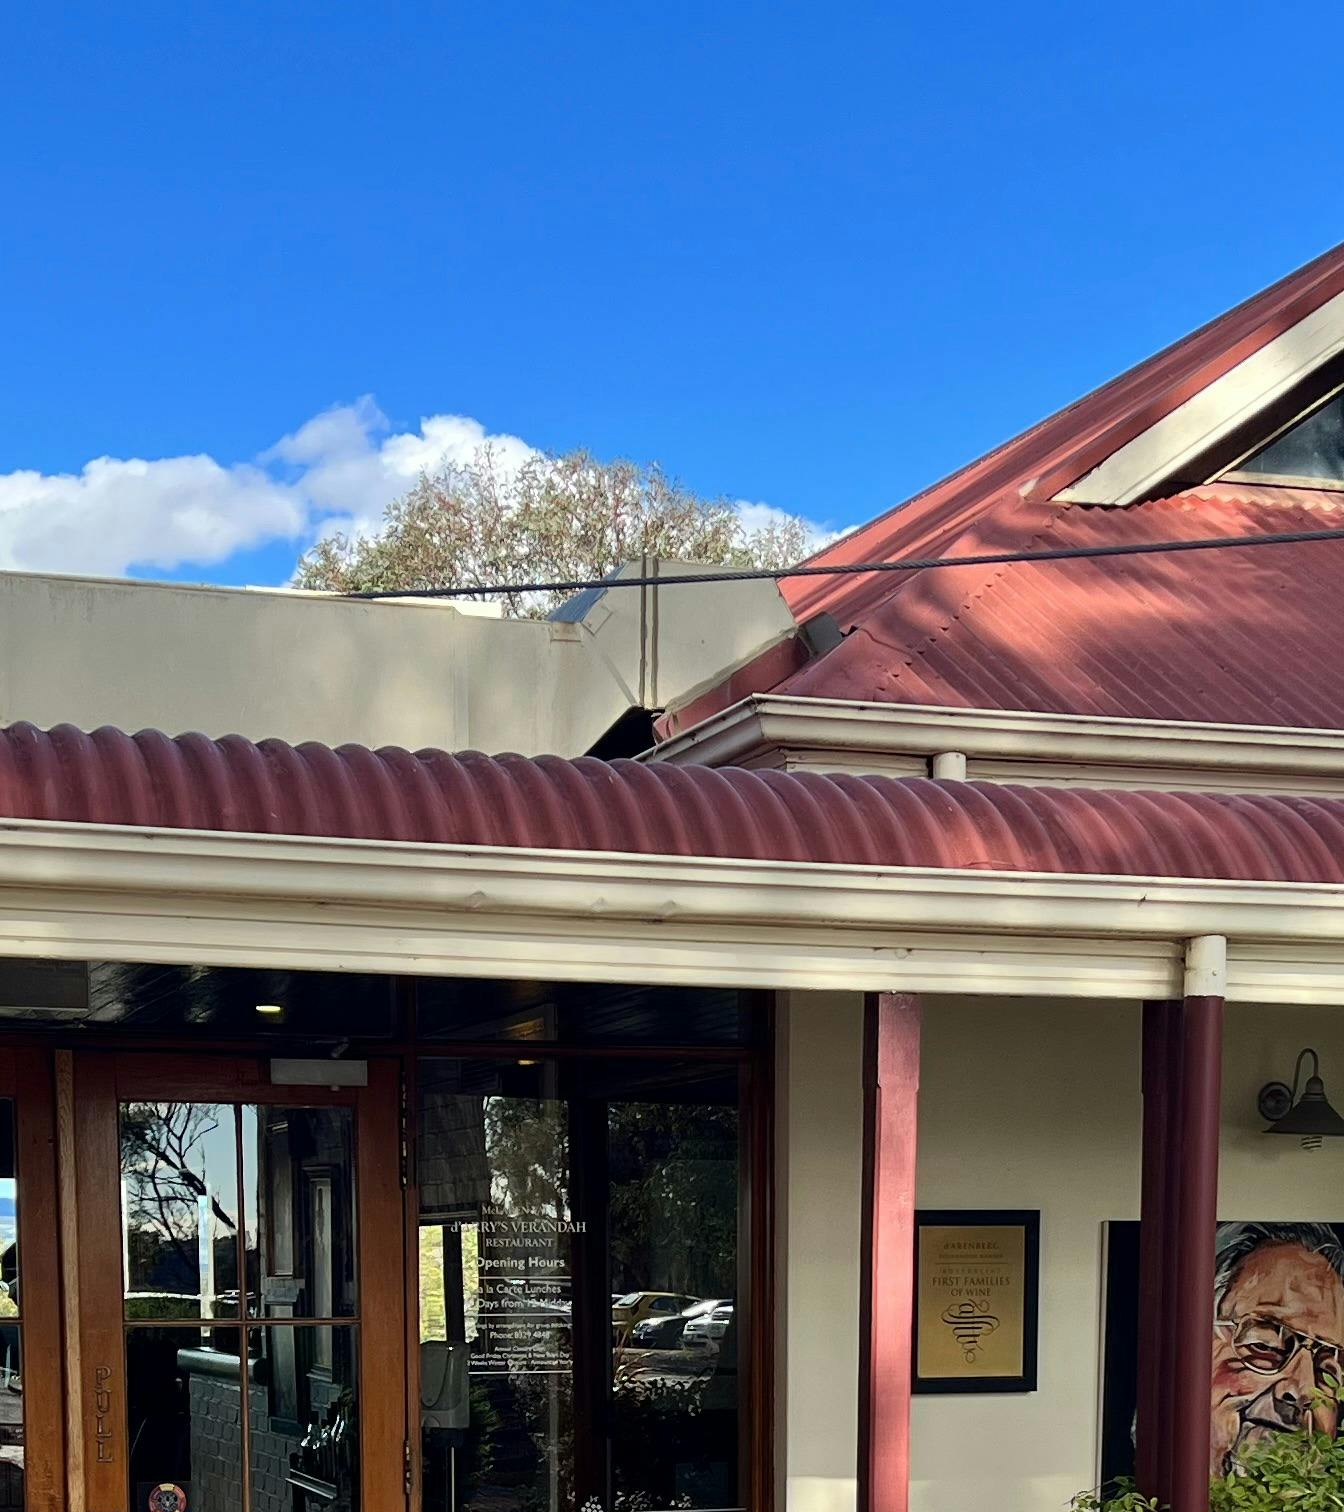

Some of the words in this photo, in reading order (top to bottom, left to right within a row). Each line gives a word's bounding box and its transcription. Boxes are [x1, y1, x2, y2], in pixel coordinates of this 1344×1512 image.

[512, 1221, 586, 1233] VERANDAH
[485, 1238, 553, 1248] RESTAURANT
[476, 1257, 525, 1271] Opening
[528, 1257, 565, 1268] Hours
[932, 1276, 960, 1287] FIRST
[964, 1276, 1010, 1287] FAMILIES
[496, 1284, 523, 1294] Carte
[525, 1285, 561, 1294] Lunches
[965, 1287, 992, 1297] WINE
[501, 1299, 525, 1308] from
[96, 1365, 113, 1464] PULL
